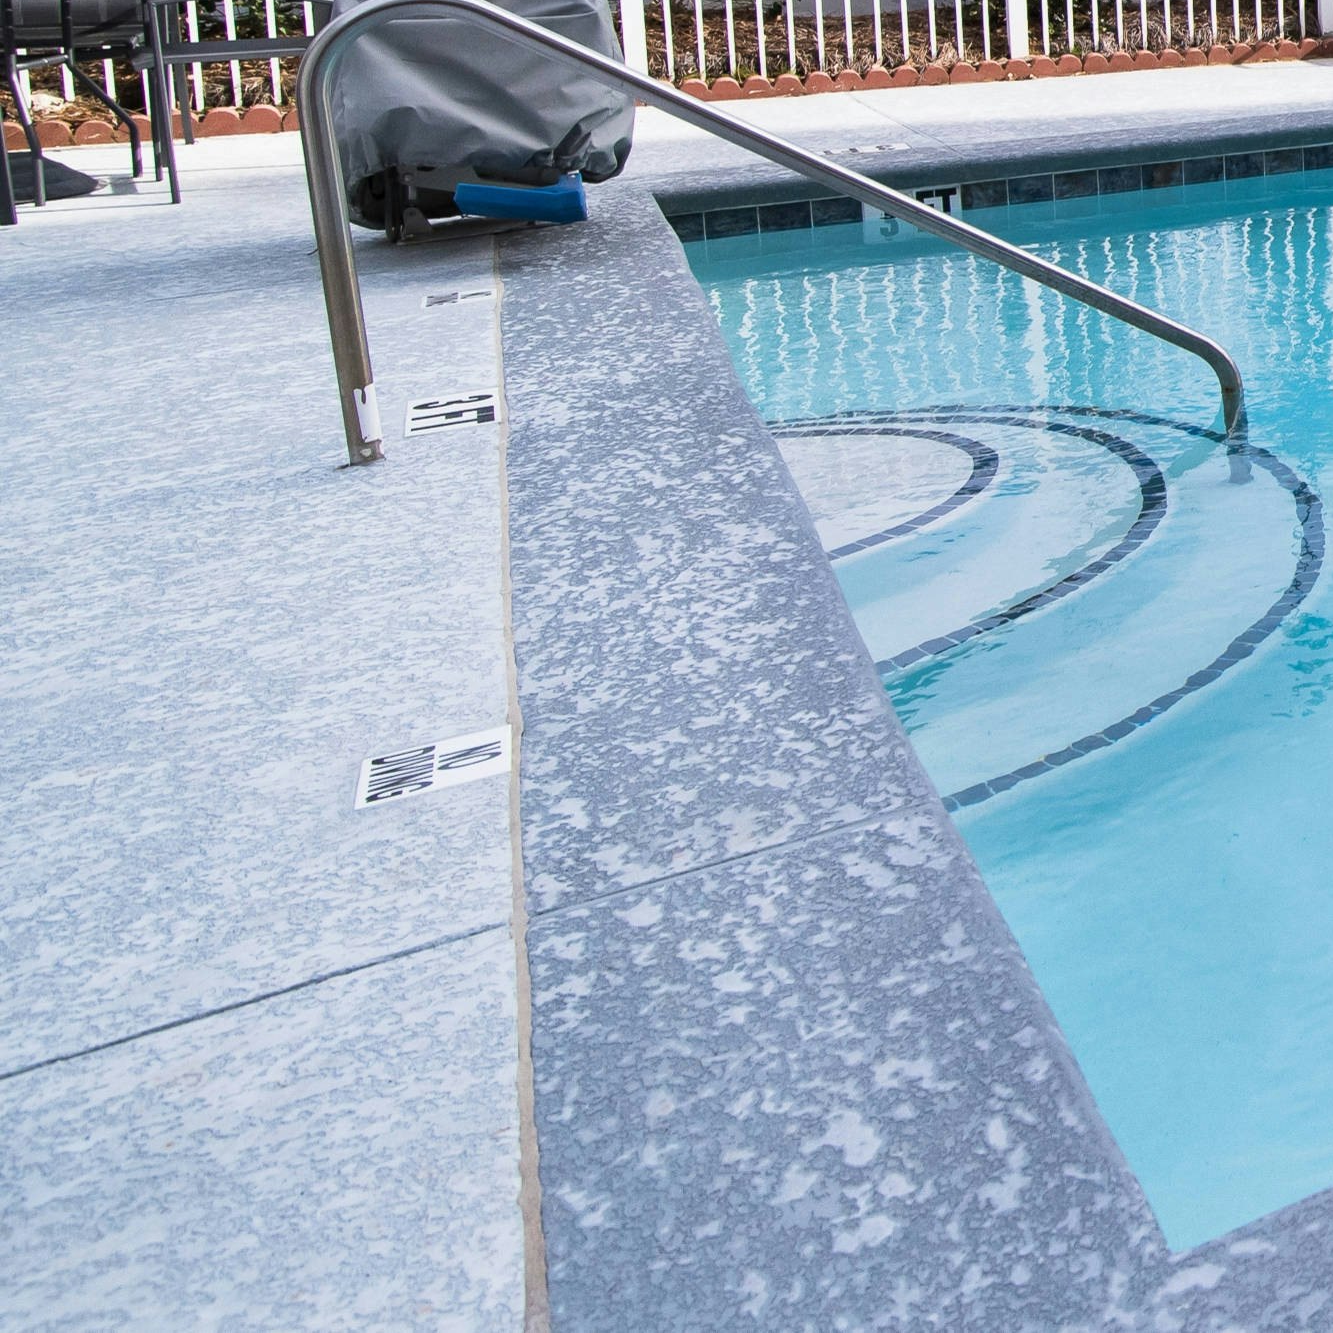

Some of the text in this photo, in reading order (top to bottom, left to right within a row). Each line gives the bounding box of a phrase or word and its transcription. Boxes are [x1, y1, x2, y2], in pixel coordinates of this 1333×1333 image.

[413, 394, 494, 410] 3
[411, 405, 496, 432] FT
[437, 740, 502, 770] NO
[365, 745, 436, 803] DIVING
